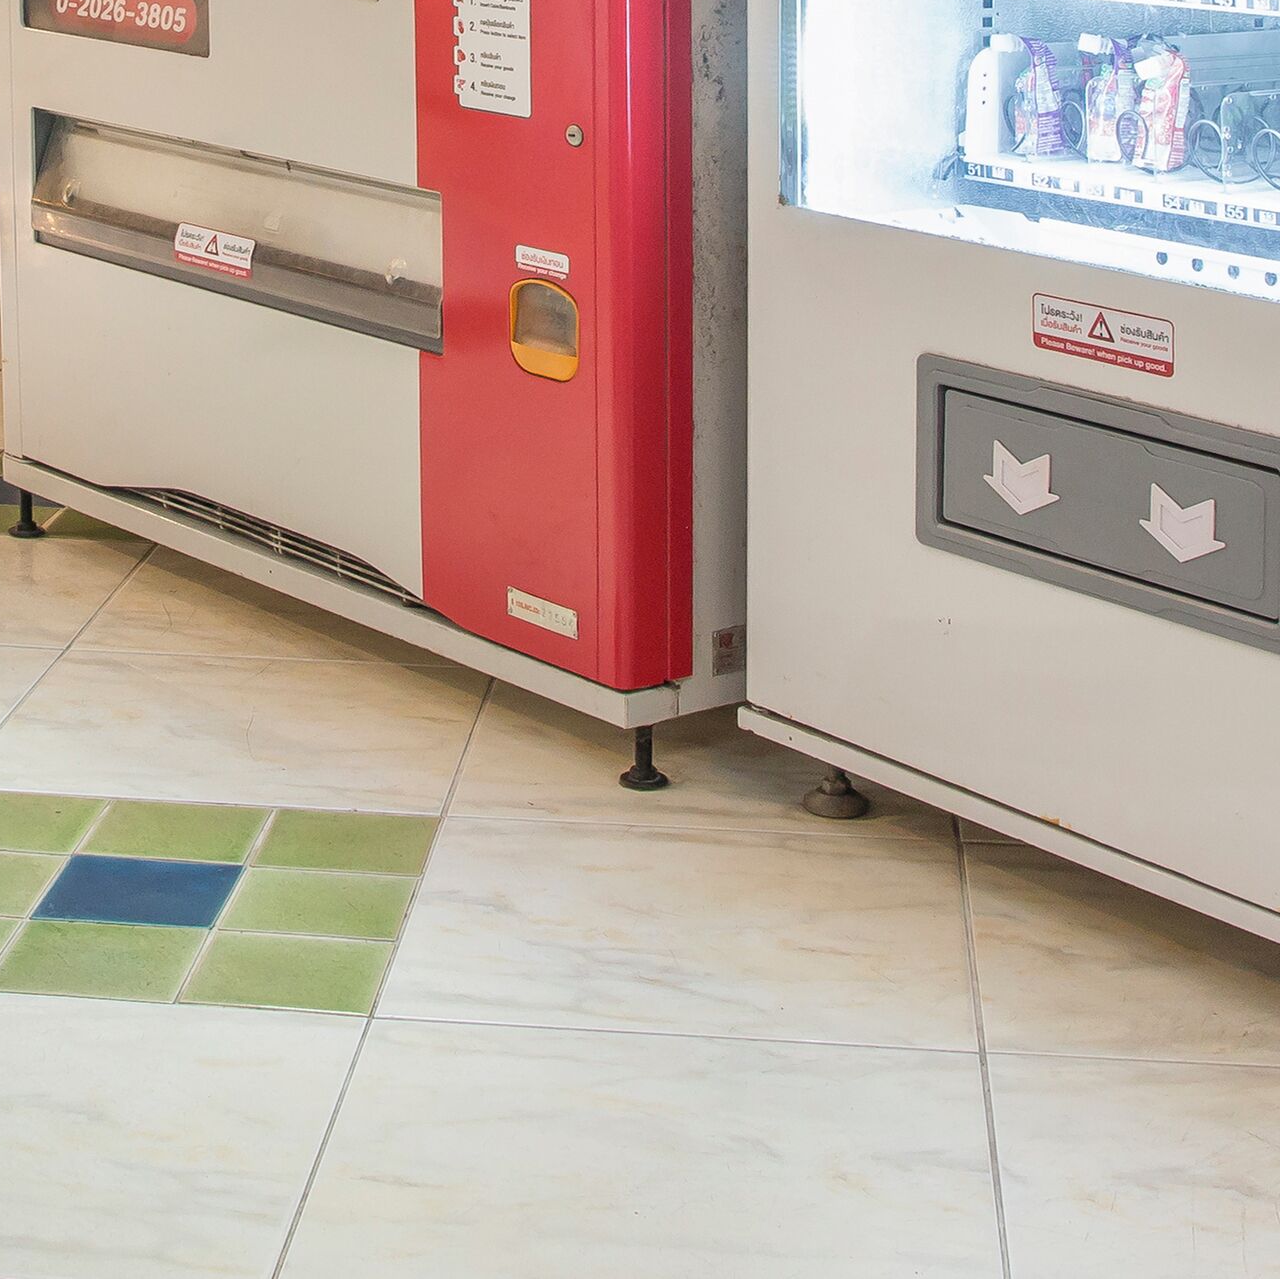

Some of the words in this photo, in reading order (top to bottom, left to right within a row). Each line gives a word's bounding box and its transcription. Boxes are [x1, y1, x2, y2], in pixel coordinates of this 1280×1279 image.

[469, 21, 477, 32] 2.
[469, 53, 477, 63] 3.
[470, 81, 477, 91] 4.
[967, 165, 982, 176] 51
[1163, 196, 1182, 210] 54
[1225, 205, 1244, 219] 55
[1041, 303, 1082, 322] โปรดระวัง!
[1120, 323, 1170, 343] ช่องรับสินค้า
[1040, 337, 1065, 350] Please
[1066, 342, 1095, 356] Beware!
[1096, 349, 1116, 361] when
[1117, 355, 1133, 365] pick
[1134, 358, 1144, 368] up
